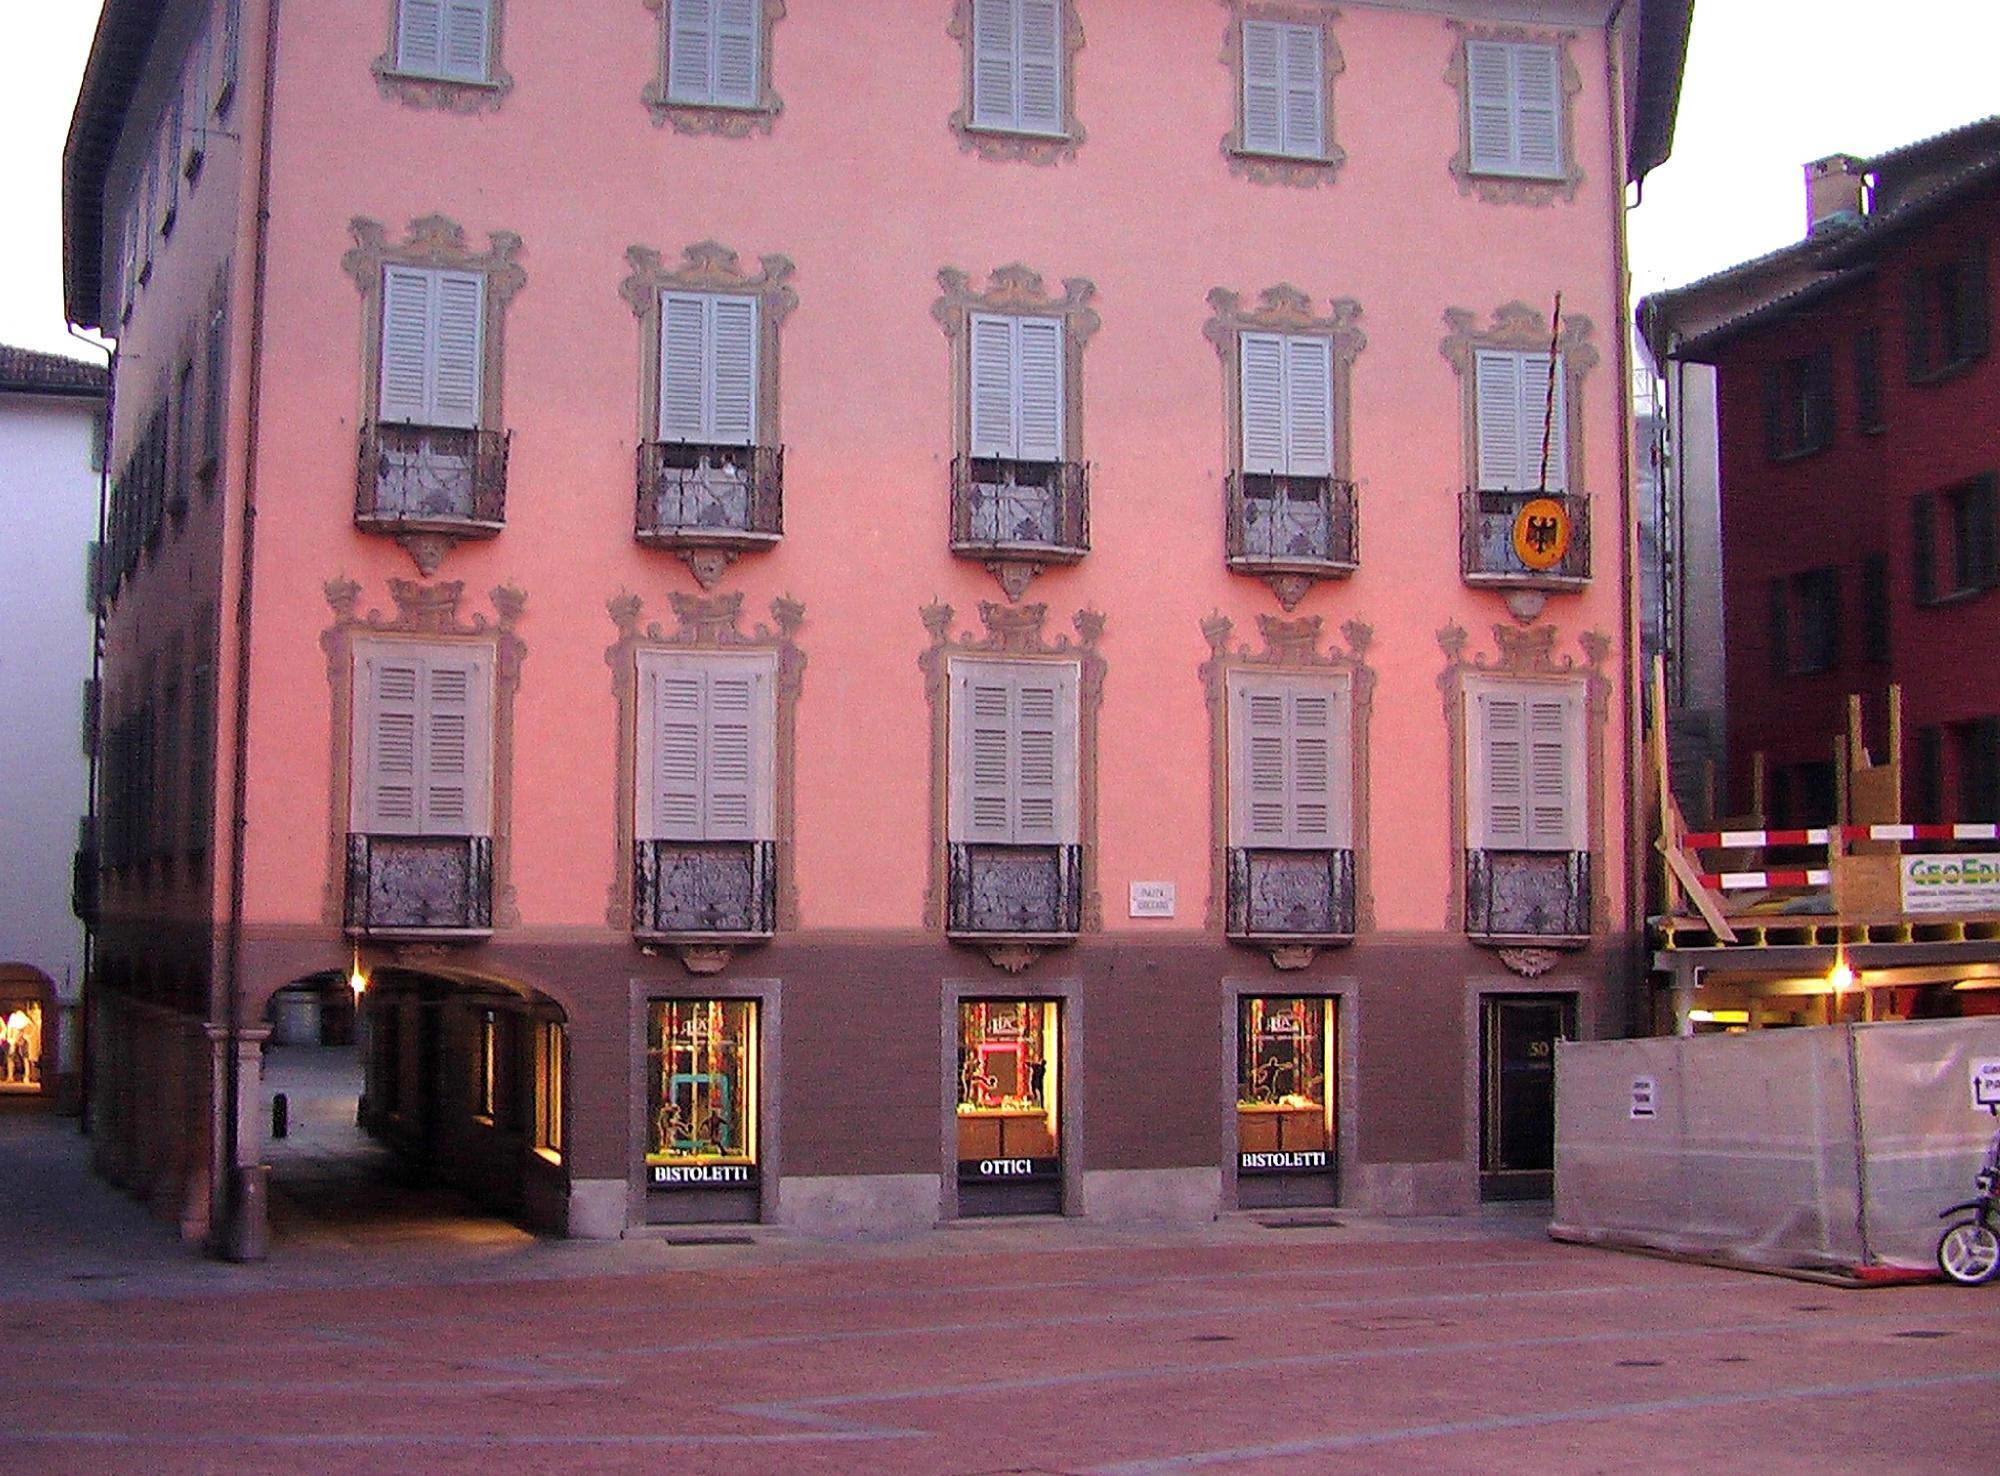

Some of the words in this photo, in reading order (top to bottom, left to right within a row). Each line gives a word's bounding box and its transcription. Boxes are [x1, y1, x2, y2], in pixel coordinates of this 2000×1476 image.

[980, 1159, 1032, 1175] OTTICI
[1242, 1151, 1326, 1167] BISTOLETTI
[655, 1165, 748, 1182] BISTOLETTI
